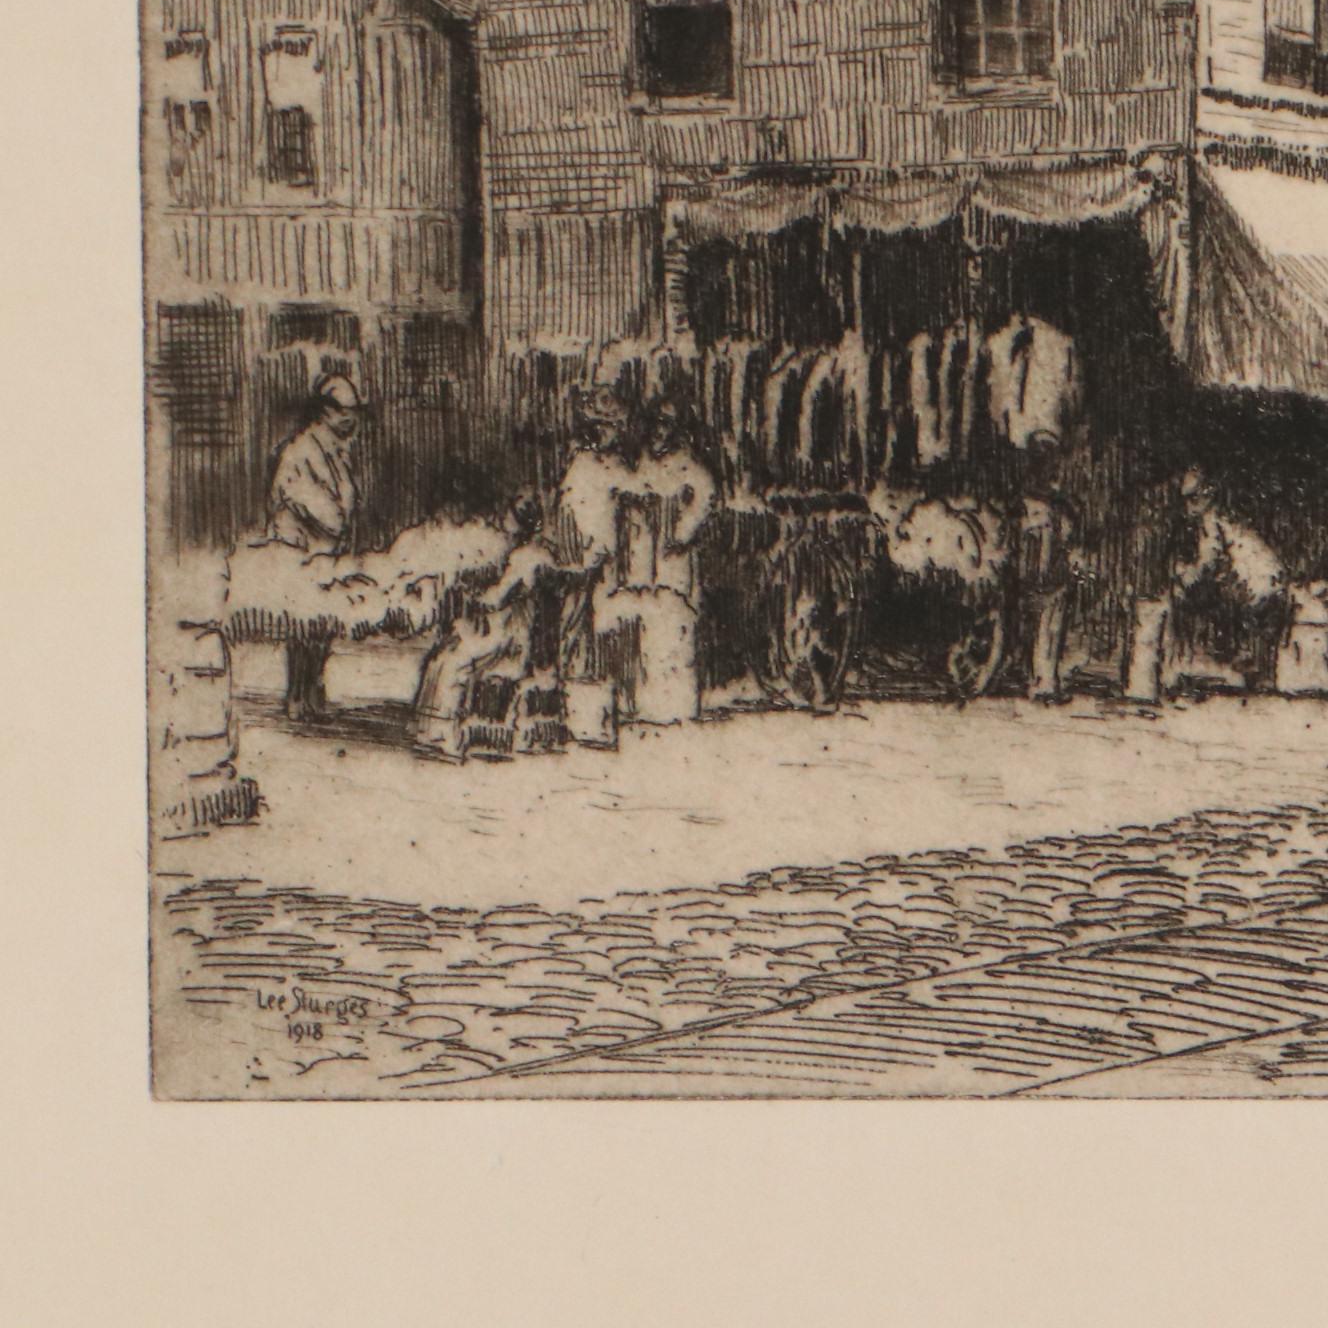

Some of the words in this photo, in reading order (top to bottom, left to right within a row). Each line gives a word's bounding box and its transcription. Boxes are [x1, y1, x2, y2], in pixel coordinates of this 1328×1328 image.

[257, 988, 286, 1011] Lee
[291, 986, 368, 1025] Sturges
[287, 1023, 323, 1043] 1918
